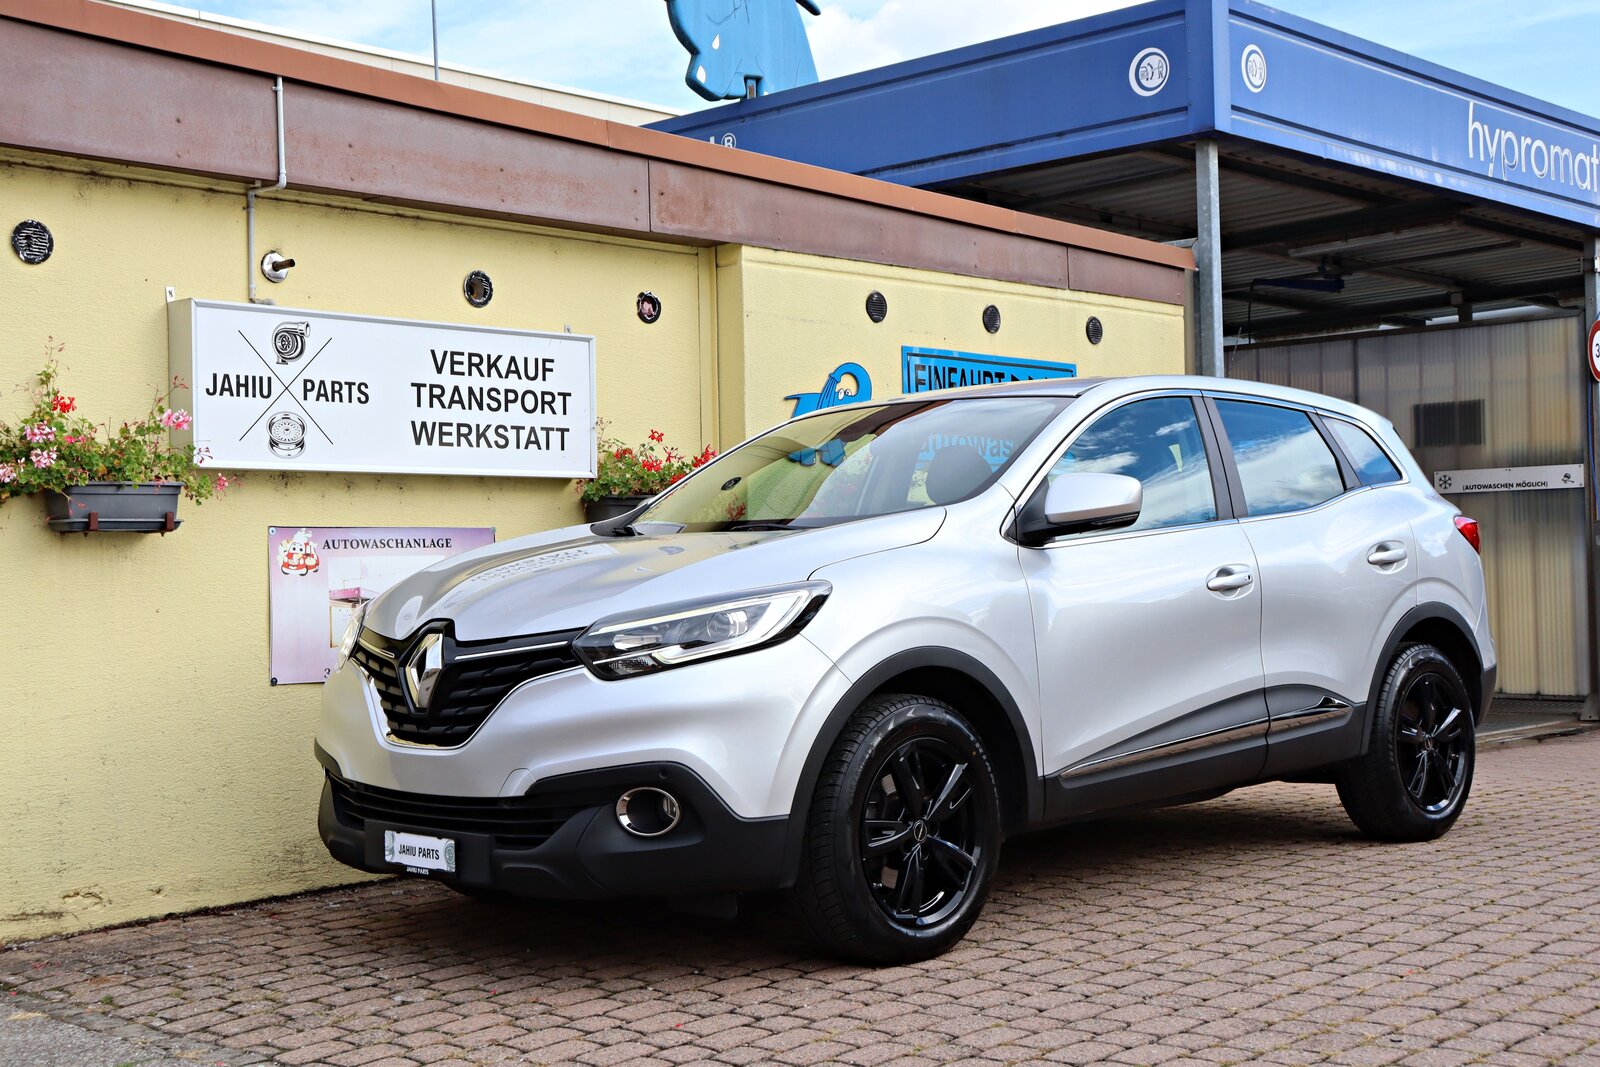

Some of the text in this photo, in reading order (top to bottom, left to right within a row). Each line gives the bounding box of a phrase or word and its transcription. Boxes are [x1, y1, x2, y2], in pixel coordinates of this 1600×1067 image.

[1468, 100, 1599, 192] hypromat
[430, 349, 555, 382] VERKAUF
[205, 372, 370, 405] JAHIU PARTS
[410, 382, 572, 416] TRANSPORT
[410, 420, 570, 451] WERKSTATT
[322, 538, 452, 550] AUTOWASCHANLAGE
[398, 844, 440, 860] JAHIU PARTS
